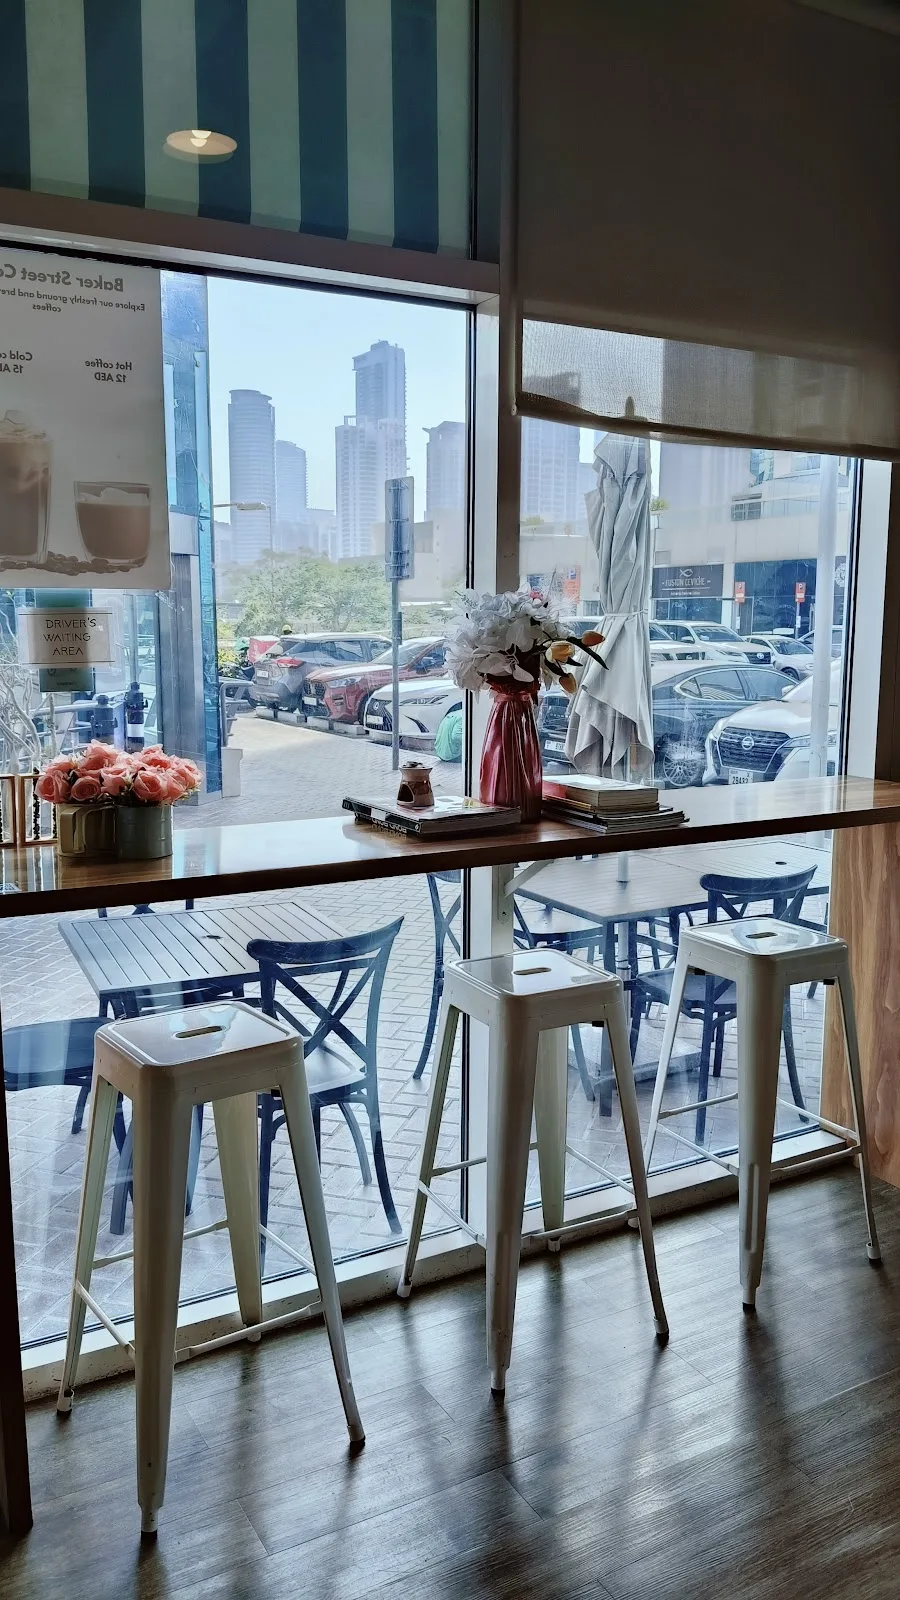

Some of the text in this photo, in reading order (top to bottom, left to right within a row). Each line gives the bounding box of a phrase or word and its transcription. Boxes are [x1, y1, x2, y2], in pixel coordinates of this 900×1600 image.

[45, 617, 97, 628] DRIVER'S
[43, 632, 91, 642] WAITING
[52, 646, 84, 656] AREA
